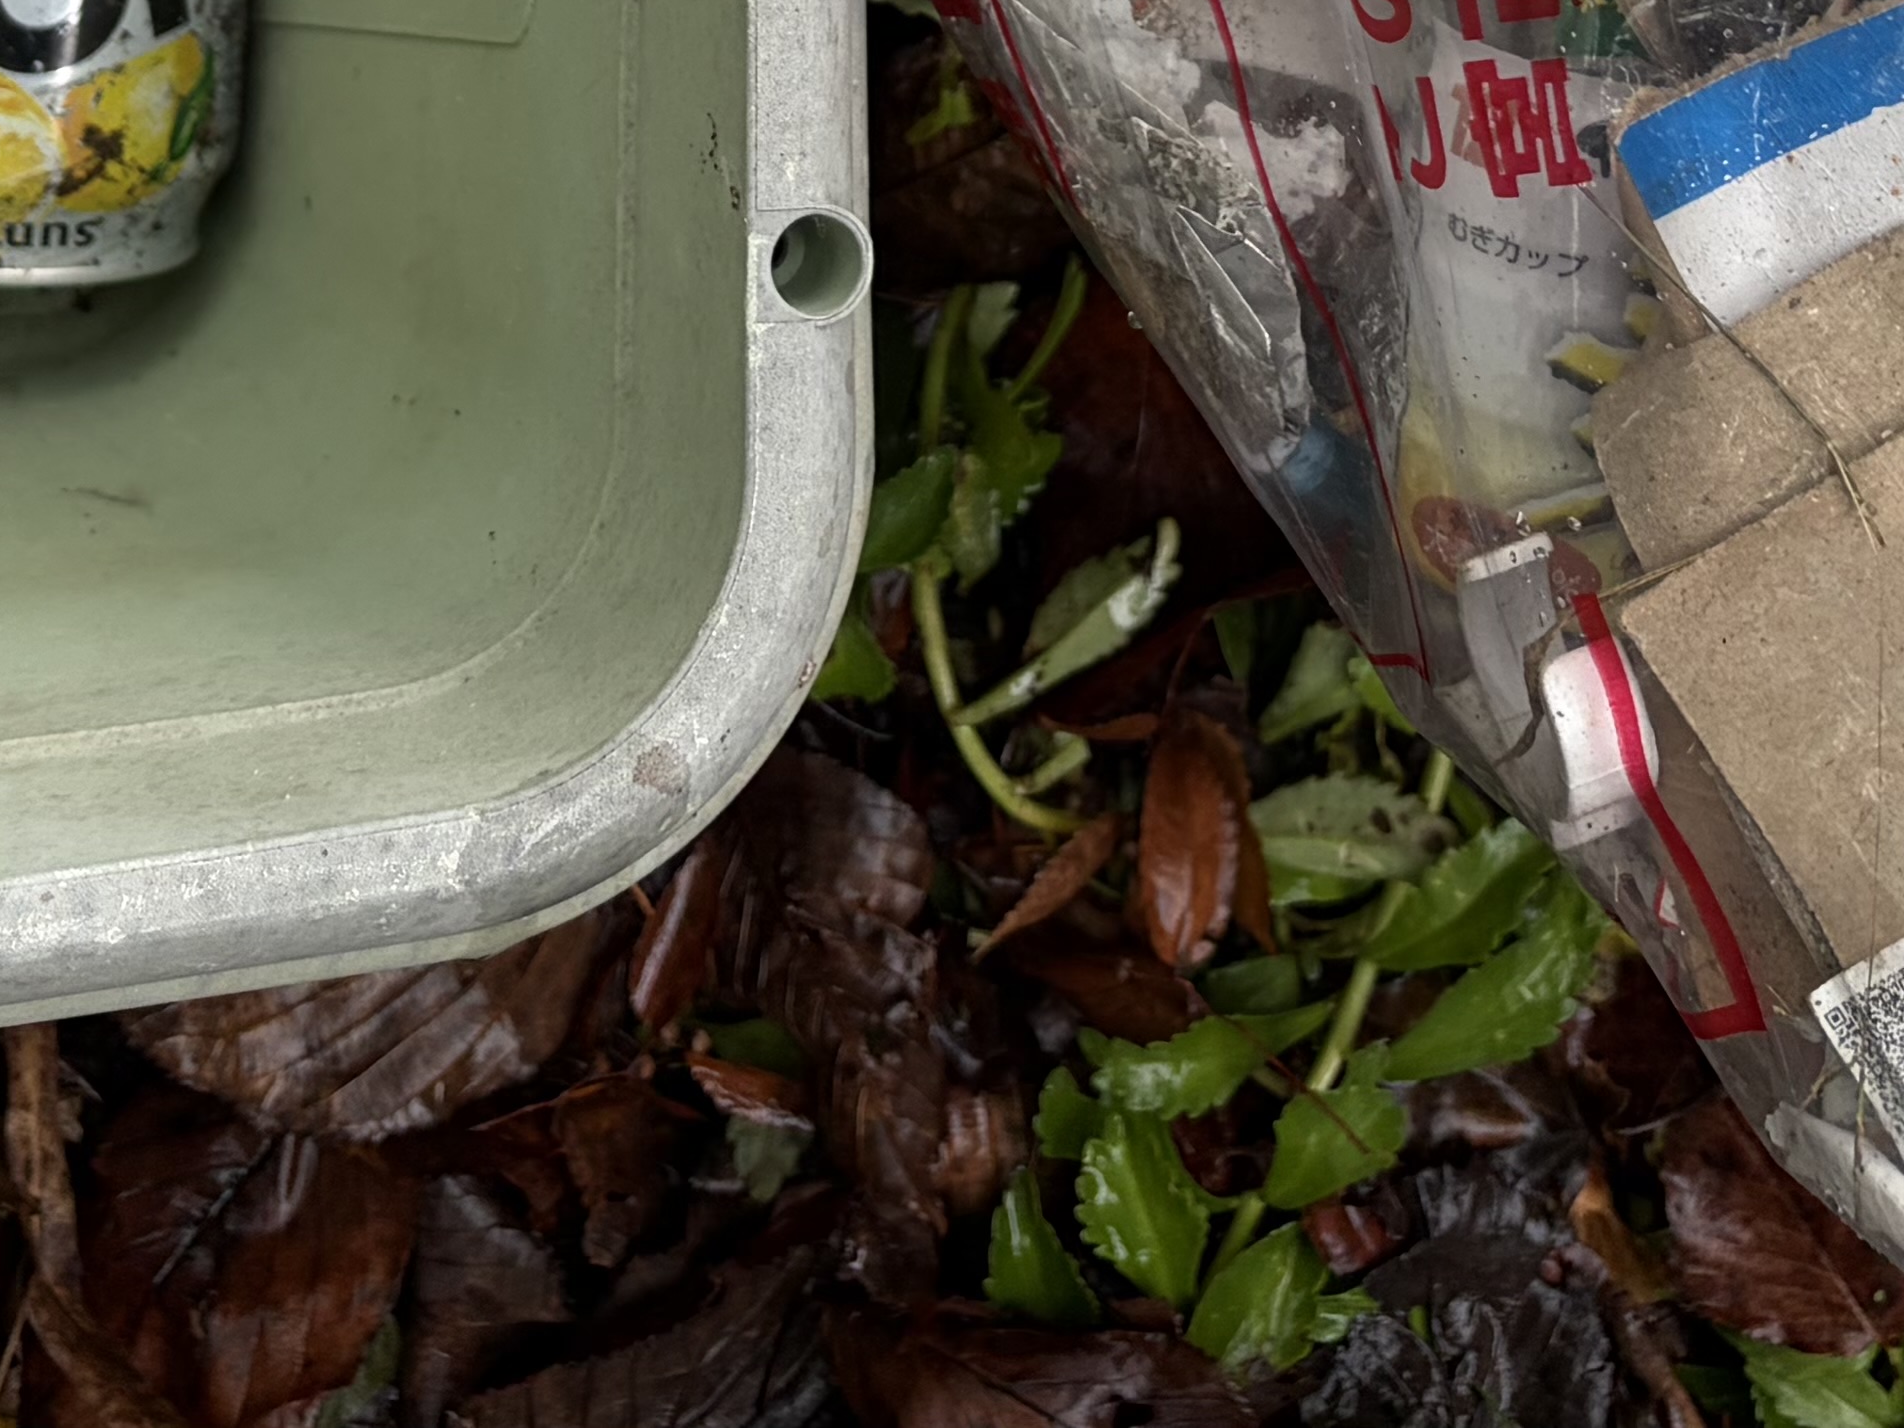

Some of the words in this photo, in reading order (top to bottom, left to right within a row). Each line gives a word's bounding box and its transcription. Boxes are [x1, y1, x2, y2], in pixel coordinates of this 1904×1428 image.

[1446, 211, 1591, 280] むぎカップ
